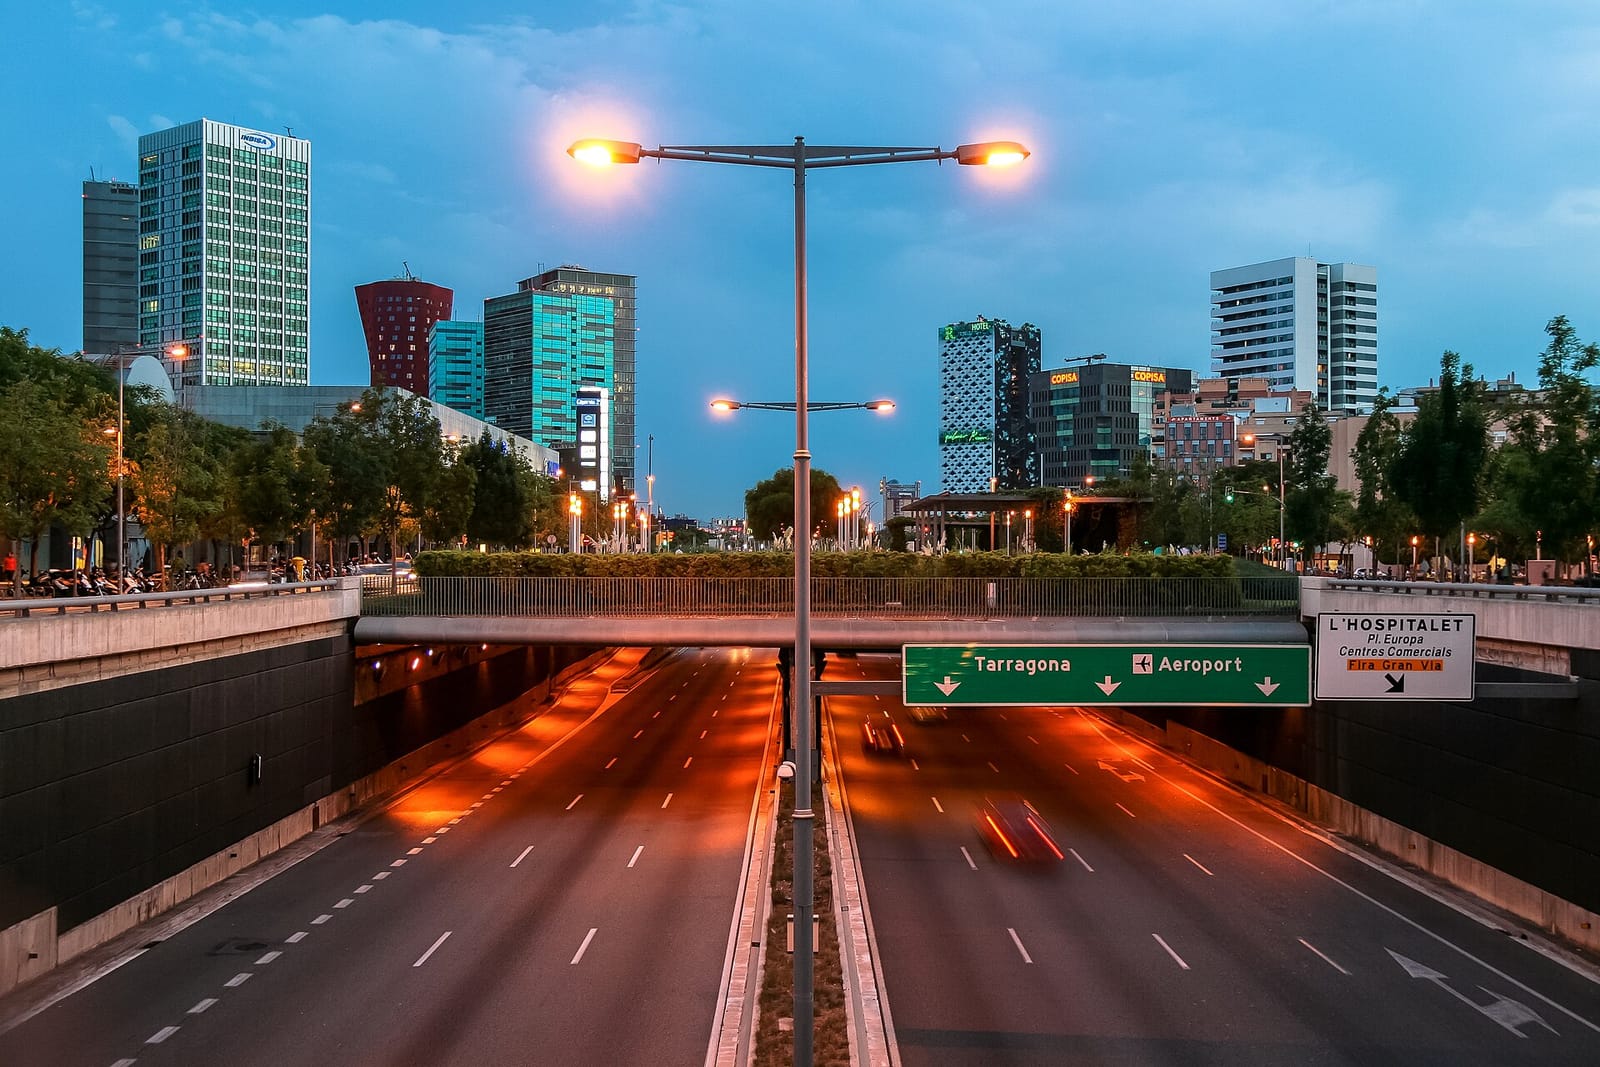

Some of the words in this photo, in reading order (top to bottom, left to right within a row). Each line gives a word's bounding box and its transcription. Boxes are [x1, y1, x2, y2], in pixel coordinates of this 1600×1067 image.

[971, 322, 989, 331] HOTEL
[1051, 372, 1078, 384] COPISA
[1134, 371, 1165, 383] COPISA
[1329, 618, 1464, 632] L'HOSPITALET
[1367, 633, 1381, 644] Pl.
[1383, 633, 1424, 646] Europa
[1339, 646, 1385, 657] Centres
[1387, 646, 1452, 657] Comercials
[974, 656, 1071, 676] Tarragona
[1158, 656, 1242, 675] Aeroport
[1349, 659, 1375, 670] Fira
[1382, 659, 1413, 670] Gran
[1420, 659, 1441, 670] Via
